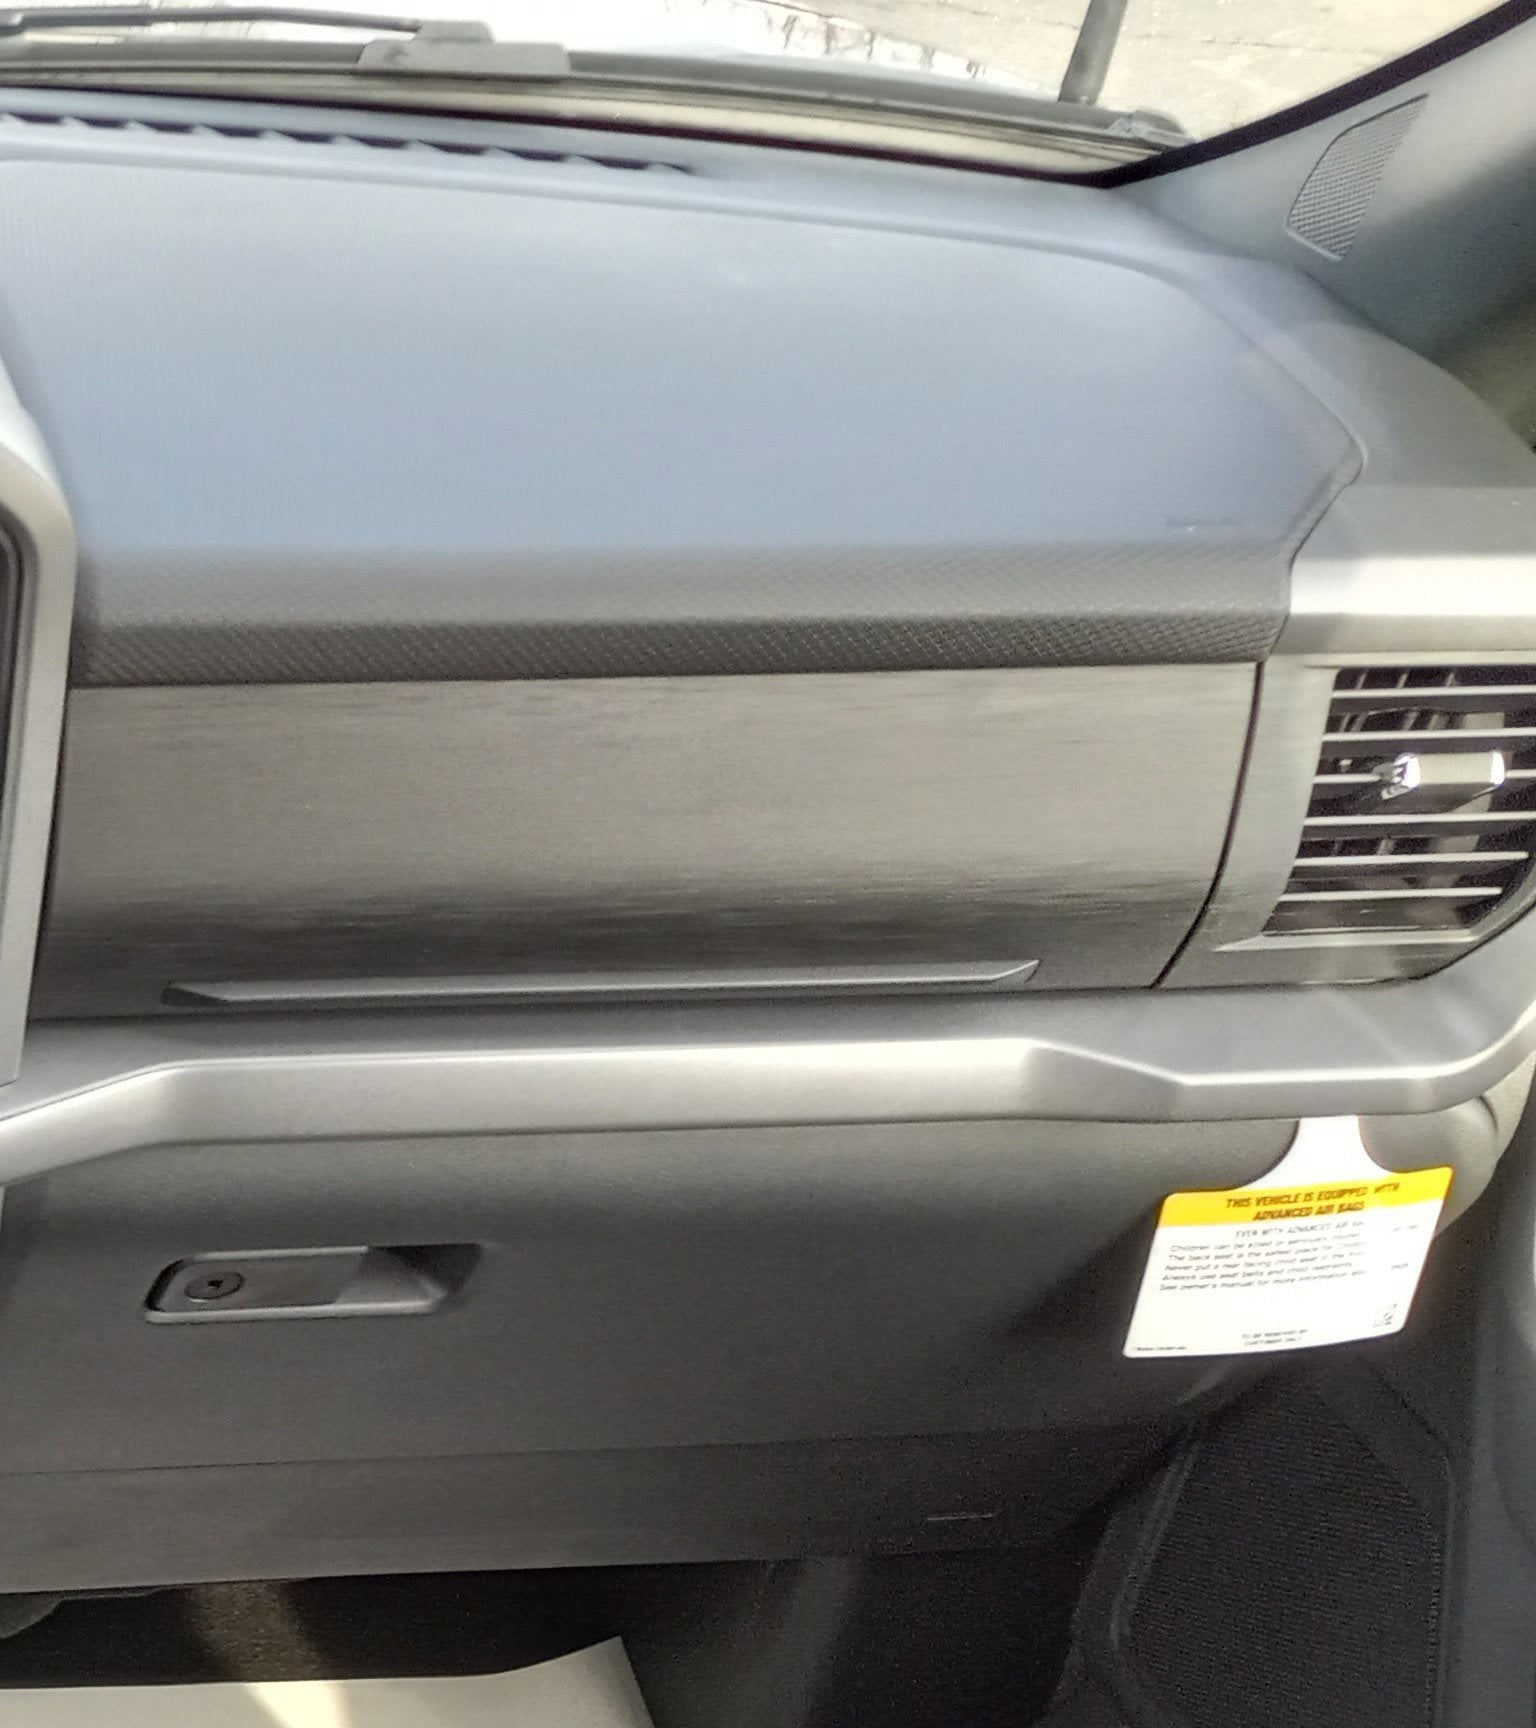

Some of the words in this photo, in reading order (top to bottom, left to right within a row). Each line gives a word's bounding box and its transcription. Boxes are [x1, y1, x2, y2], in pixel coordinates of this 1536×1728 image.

[1227, 1196, 1252, 1208] THIS
[1253, 1206, 1313, 1221] ADVANCED
[1316, 1203, 1335, 1216] AIR
